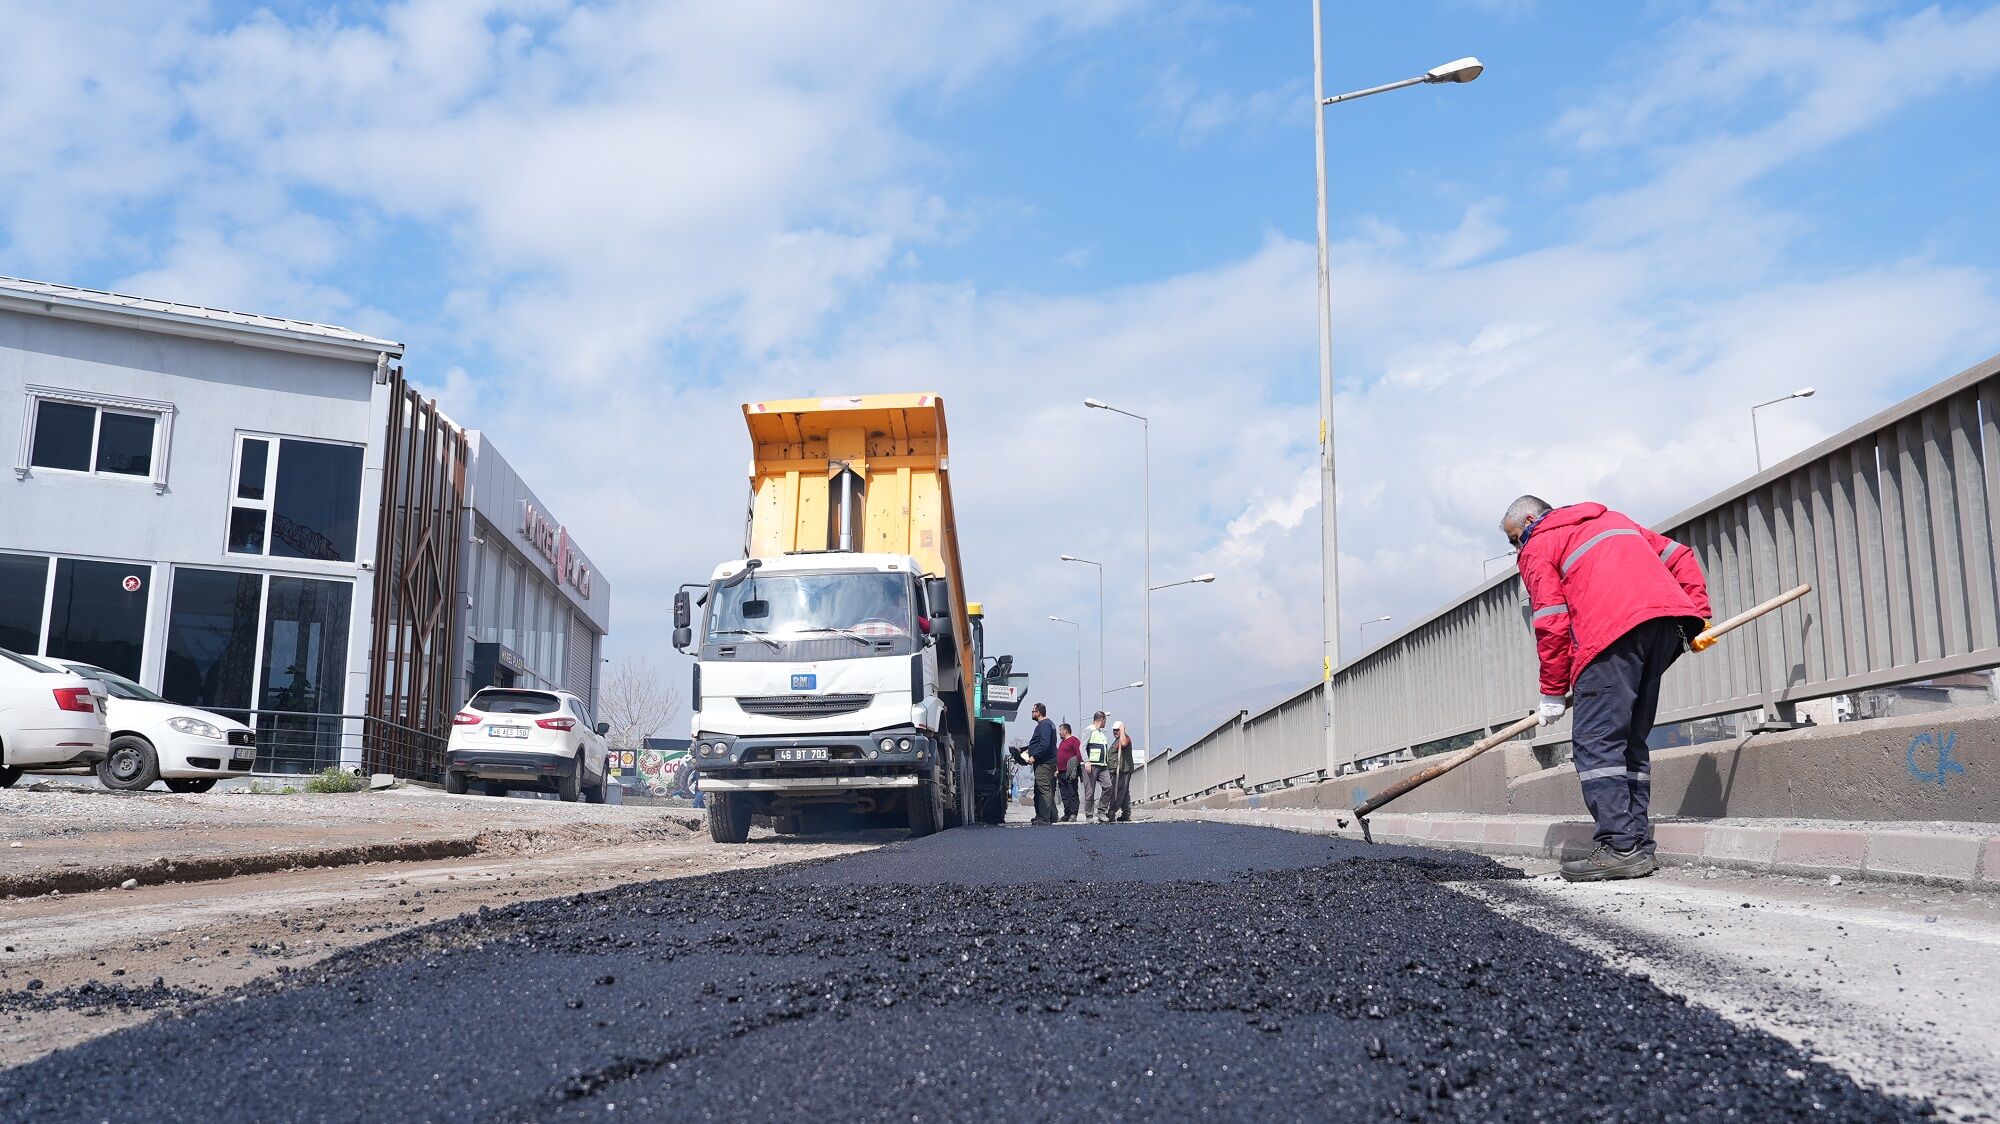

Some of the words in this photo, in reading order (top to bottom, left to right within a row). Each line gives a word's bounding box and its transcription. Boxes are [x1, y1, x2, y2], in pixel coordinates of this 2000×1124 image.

[792, 676, 814, 688] BMC
[781, 750, 792, 760] 46
[796, 749, 807, 759] BT
[811, 749, 827, 759] 703
[1906, 729, 1967, 791] CK
